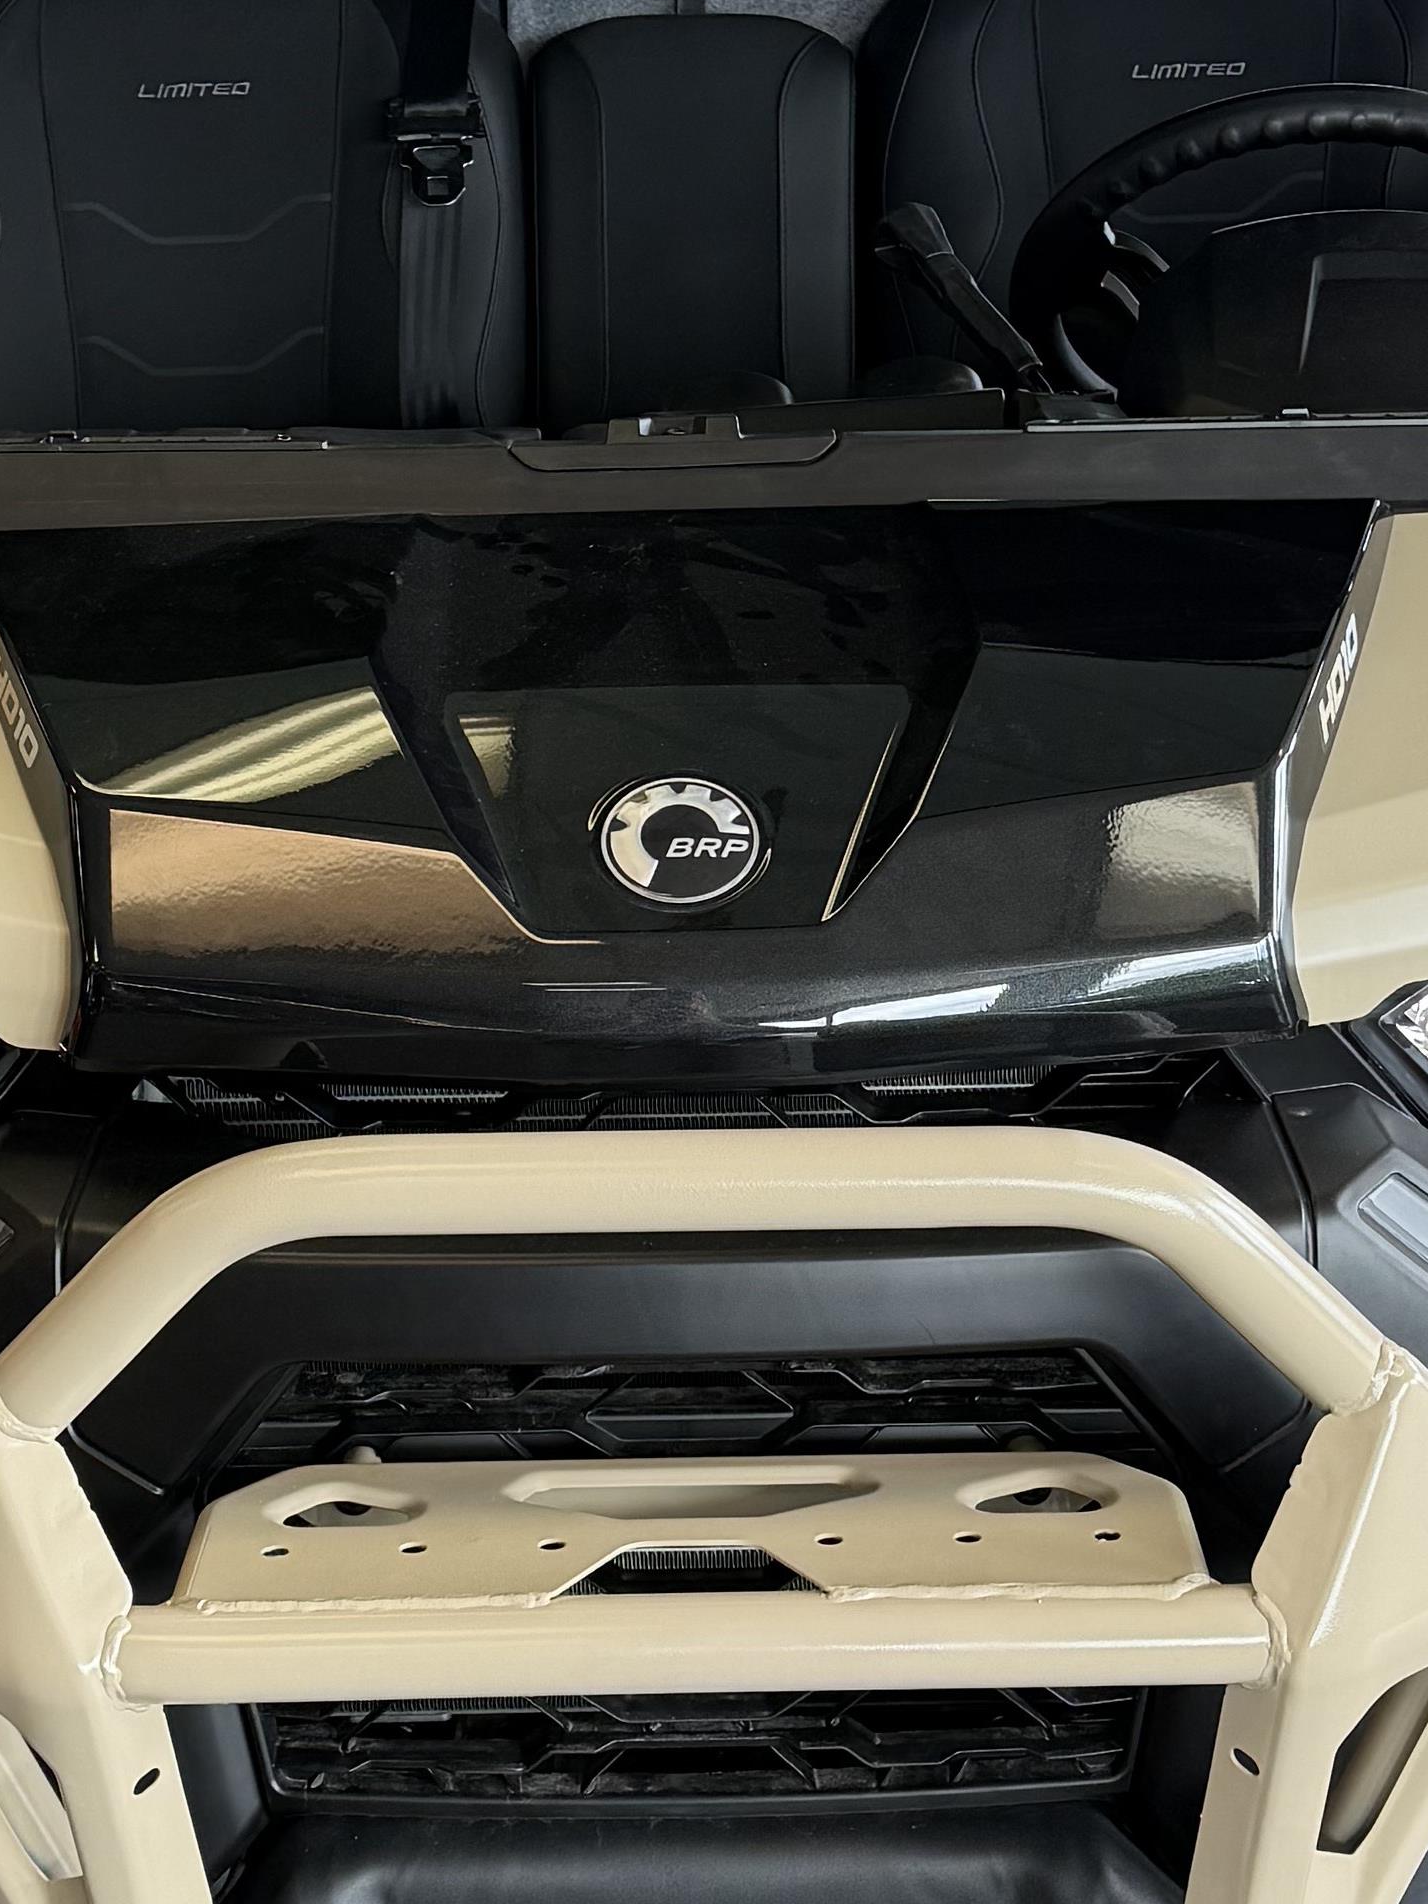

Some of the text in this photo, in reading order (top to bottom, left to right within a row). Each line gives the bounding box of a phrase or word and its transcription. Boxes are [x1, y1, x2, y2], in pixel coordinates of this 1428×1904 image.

[1132, 62, 1247, 80] LIMITED
[138, 81, 251, 99] LIMITED
[1318, 612, 1359, 745] HD10
[665, 837, 750, 858] BRP
